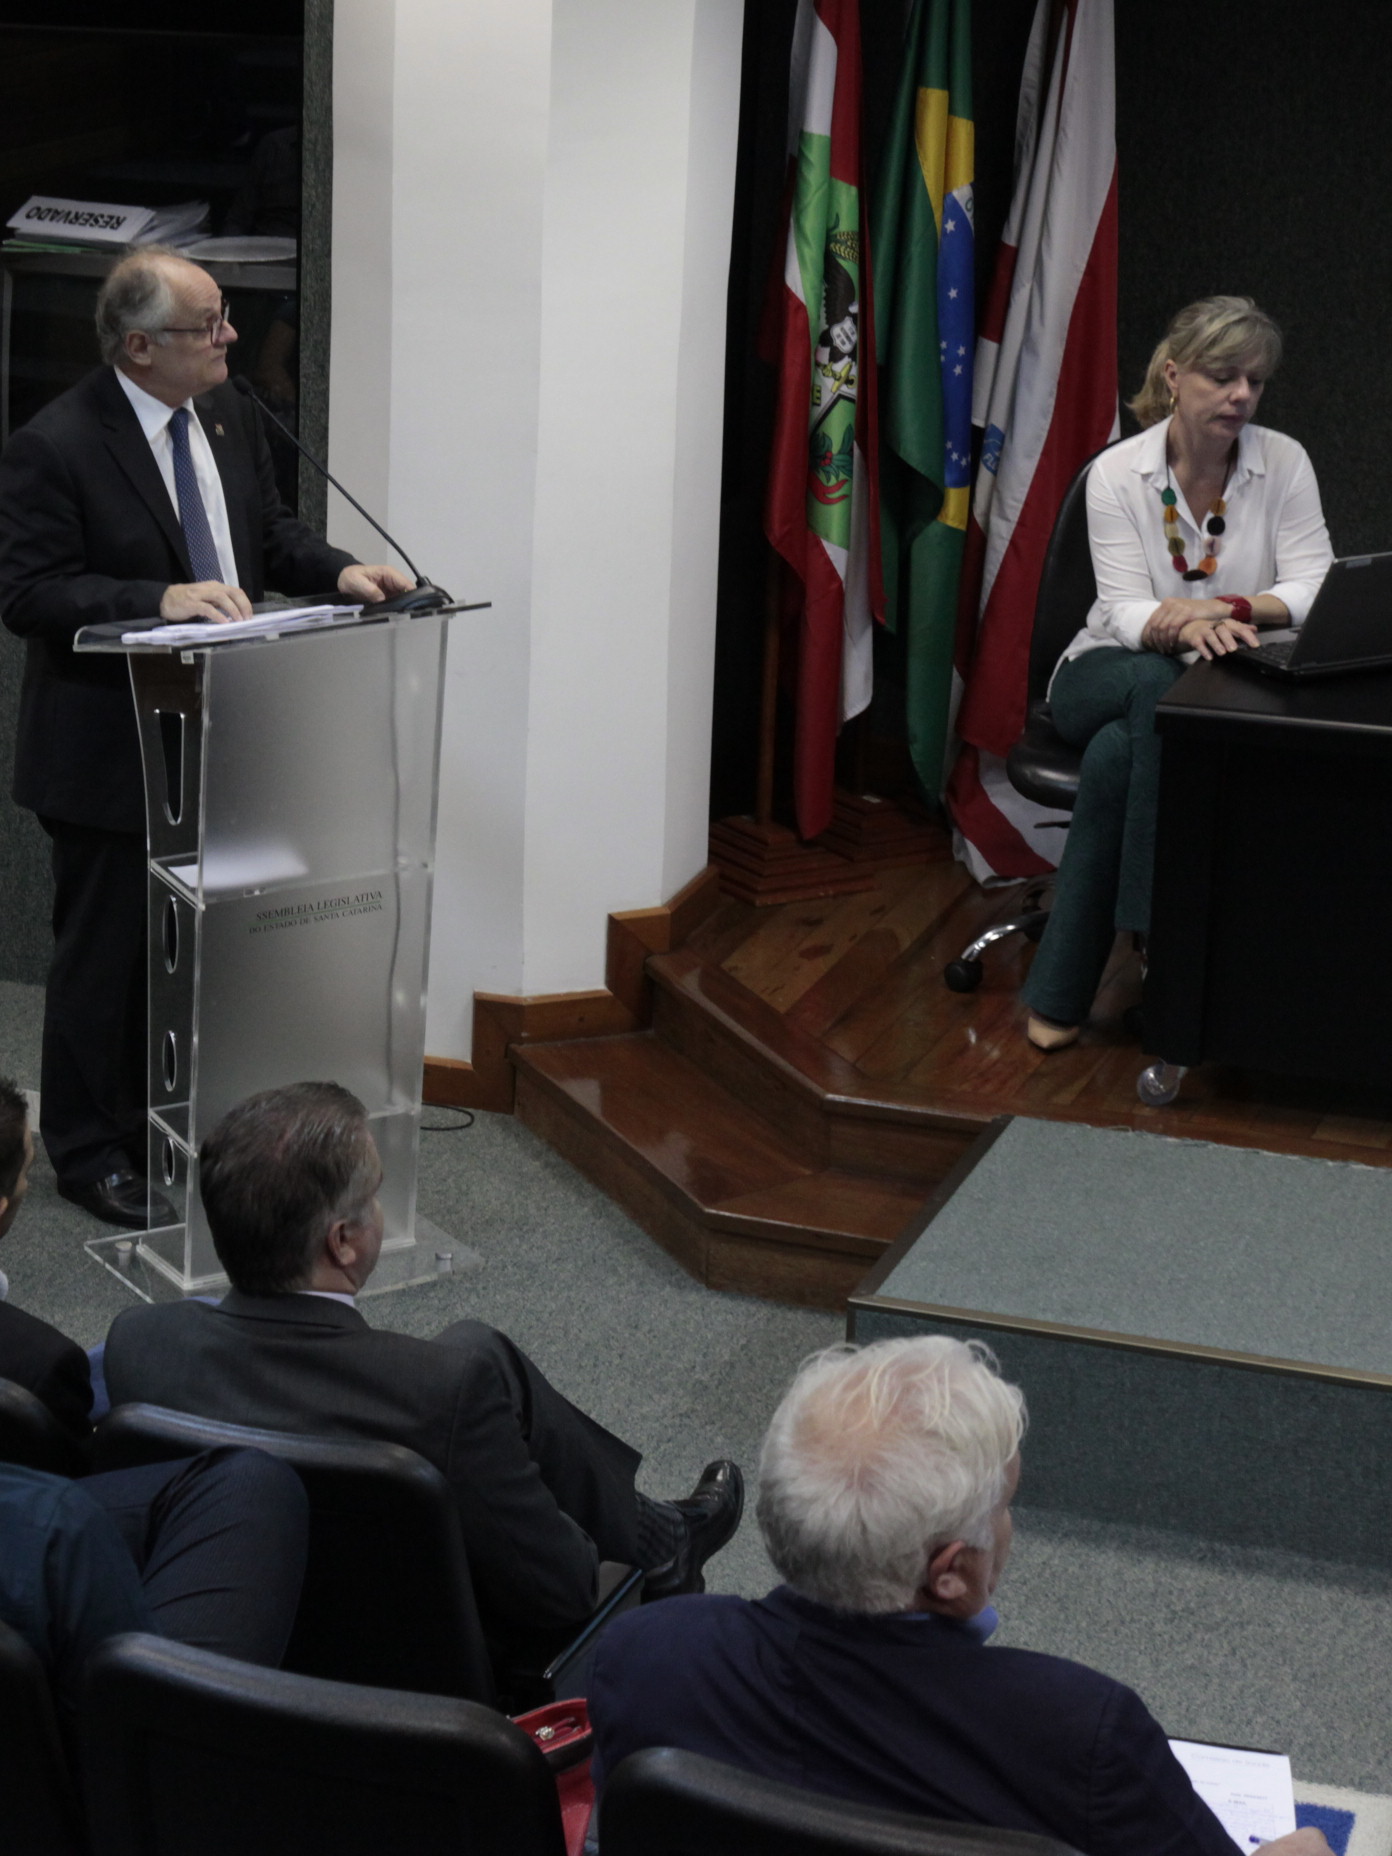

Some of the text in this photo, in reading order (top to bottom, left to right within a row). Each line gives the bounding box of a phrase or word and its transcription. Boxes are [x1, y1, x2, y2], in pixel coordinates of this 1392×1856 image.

[24, 205, 127, 231] RESERVADO
[317, 890, 383, 911] LEGISLATIVA
[249, 926, 261, 934] DO
[263, 919, 298, 933] ESTADO
[313, 912, 340, 921] SANTA
[342, 903, 383, 917] CATARINA
